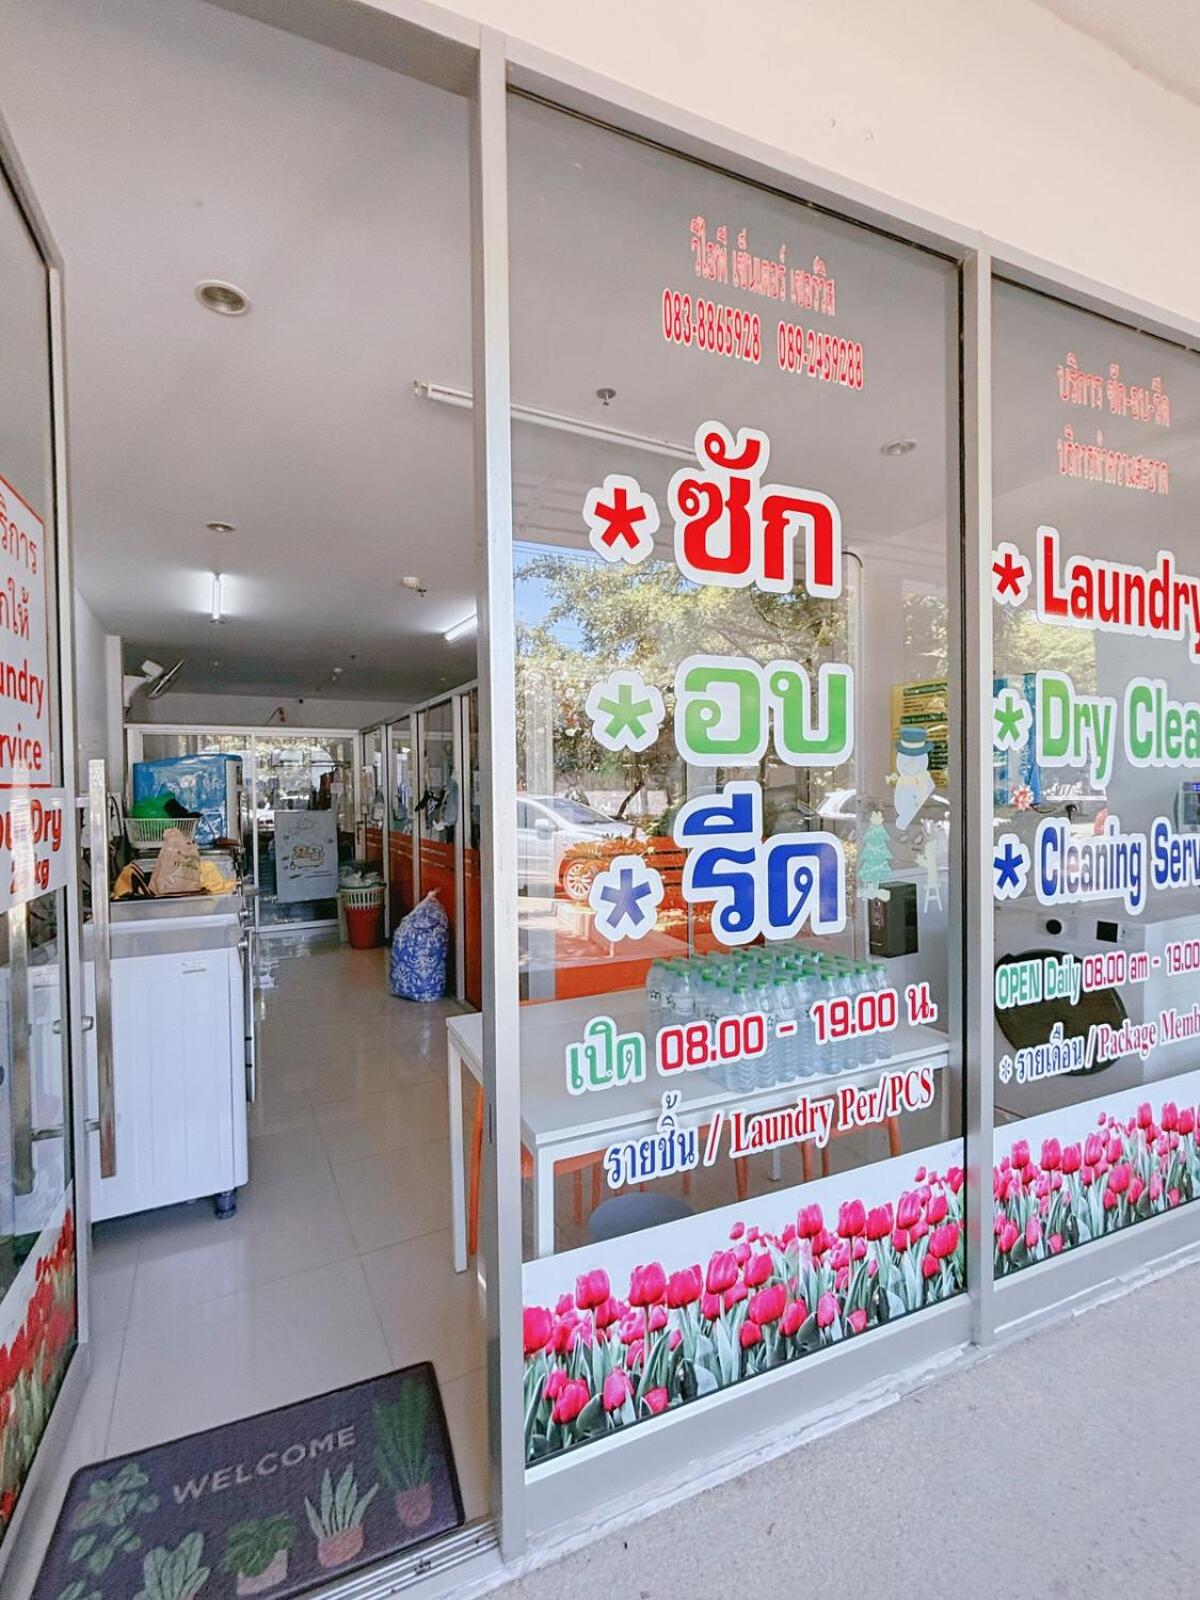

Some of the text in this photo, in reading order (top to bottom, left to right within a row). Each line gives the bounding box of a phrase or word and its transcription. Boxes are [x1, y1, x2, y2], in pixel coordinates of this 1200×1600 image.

[661, 288, 864, 390] 083-8865928 089-2459288
[675, 428, 836, 588] ซัก
[682, 664, 849, 757] อบ
[1040, 676, 1113, 781] Dry
[681, 791, 840, 934] รีด
[1040, 824, 1143, 907] Cleaning
[997, 961, 1041, 1006] OPEN
[1045, 956, 1081, 1005] Daily
[1083, 952, 1126, 990] 08.00
[1130, 954, 1148, 980] am
[569, 1018, 643, 1091] เปิด
[659, 1013, 766, 1072] 08.00
[812, 991, 896, 1042] 19.00
[907, 984, 936, 1022] น.
[606, 1092, 697, 1184] รายชิ้น
[731, 1096, 832, 1155] Laundry
[838, 1066, 934, 1127] Per/PCS
[172, 1425, 357, 1506] WELCOME
